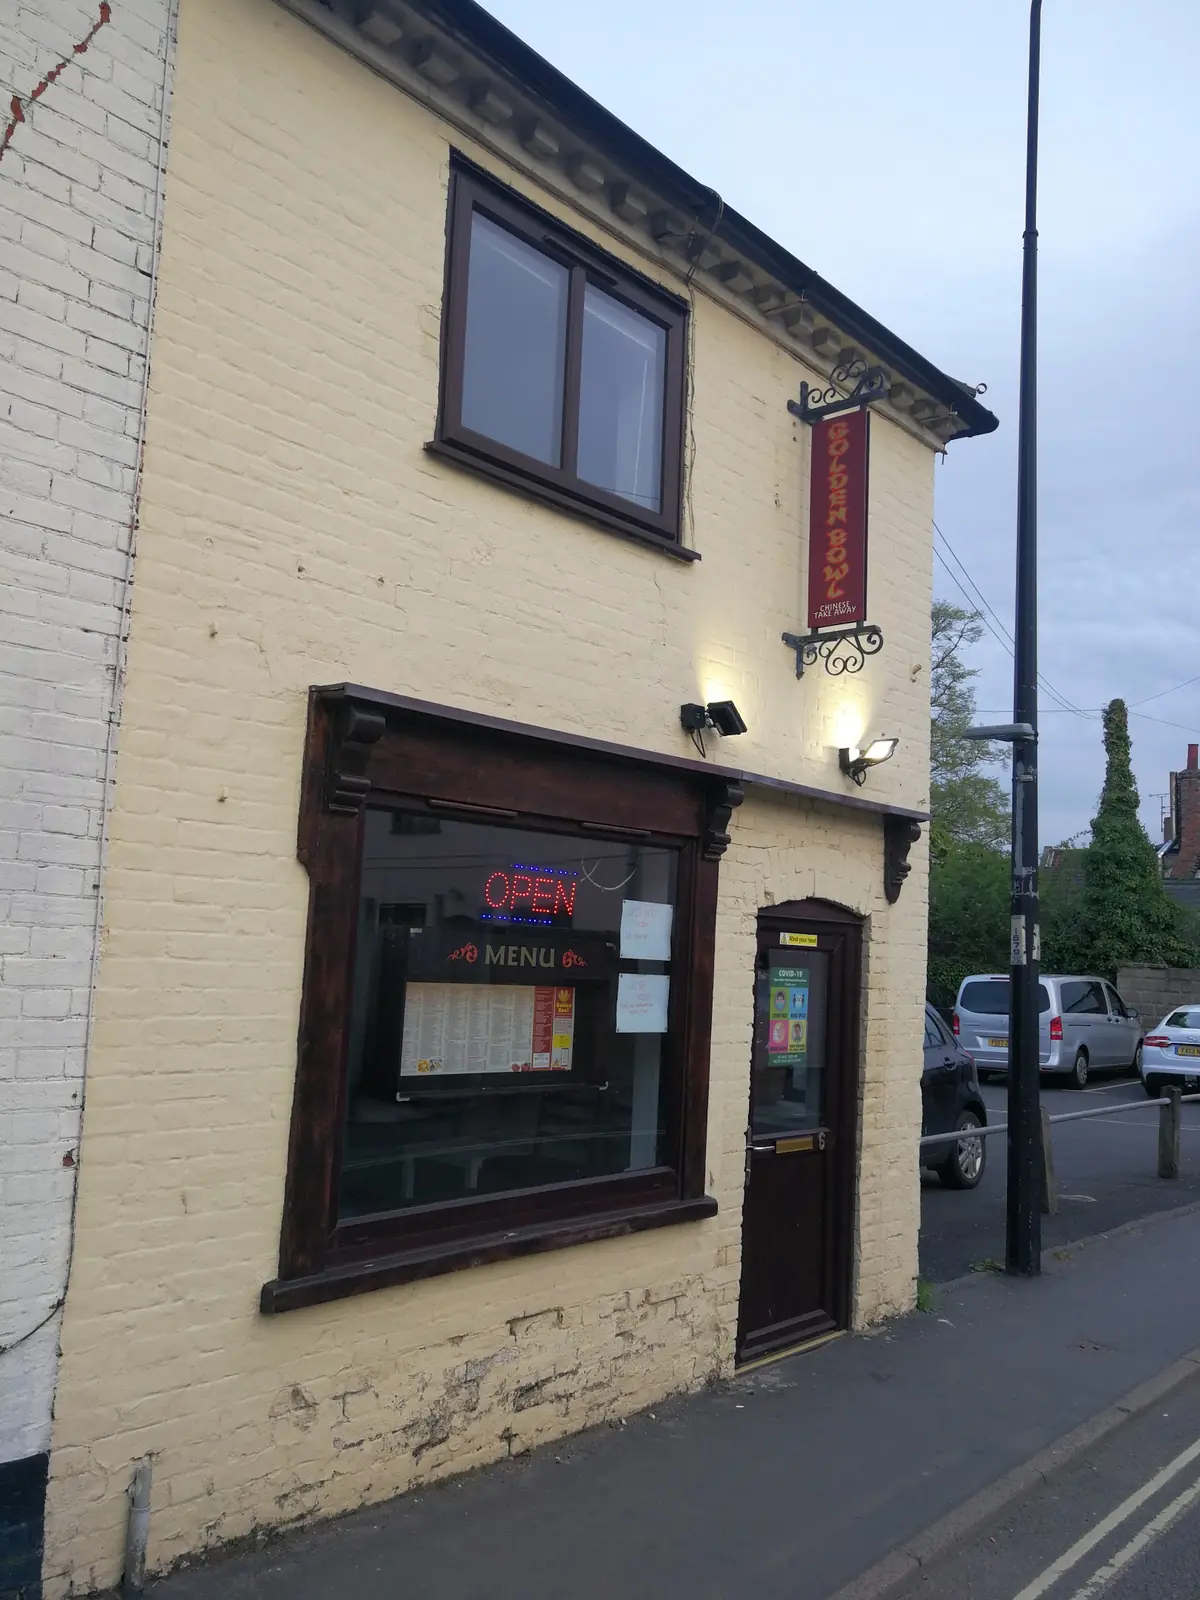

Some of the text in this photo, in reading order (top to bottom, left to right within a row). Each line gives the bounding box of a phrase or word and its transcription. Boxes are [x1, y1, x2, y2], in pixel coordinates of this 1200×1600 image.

[823, 421, 850, 600] GOLDEN BOWL
[813, 605, 857, 620] TAKE AWAY
[819, 600, 850, 612] CHINESE
[484, 871, 578, 917] OPEN
[485, 943, 556, 969] MENU
[778, 969, 803, 978] COVID-19
[818, 1132, 826, 1151] 6
